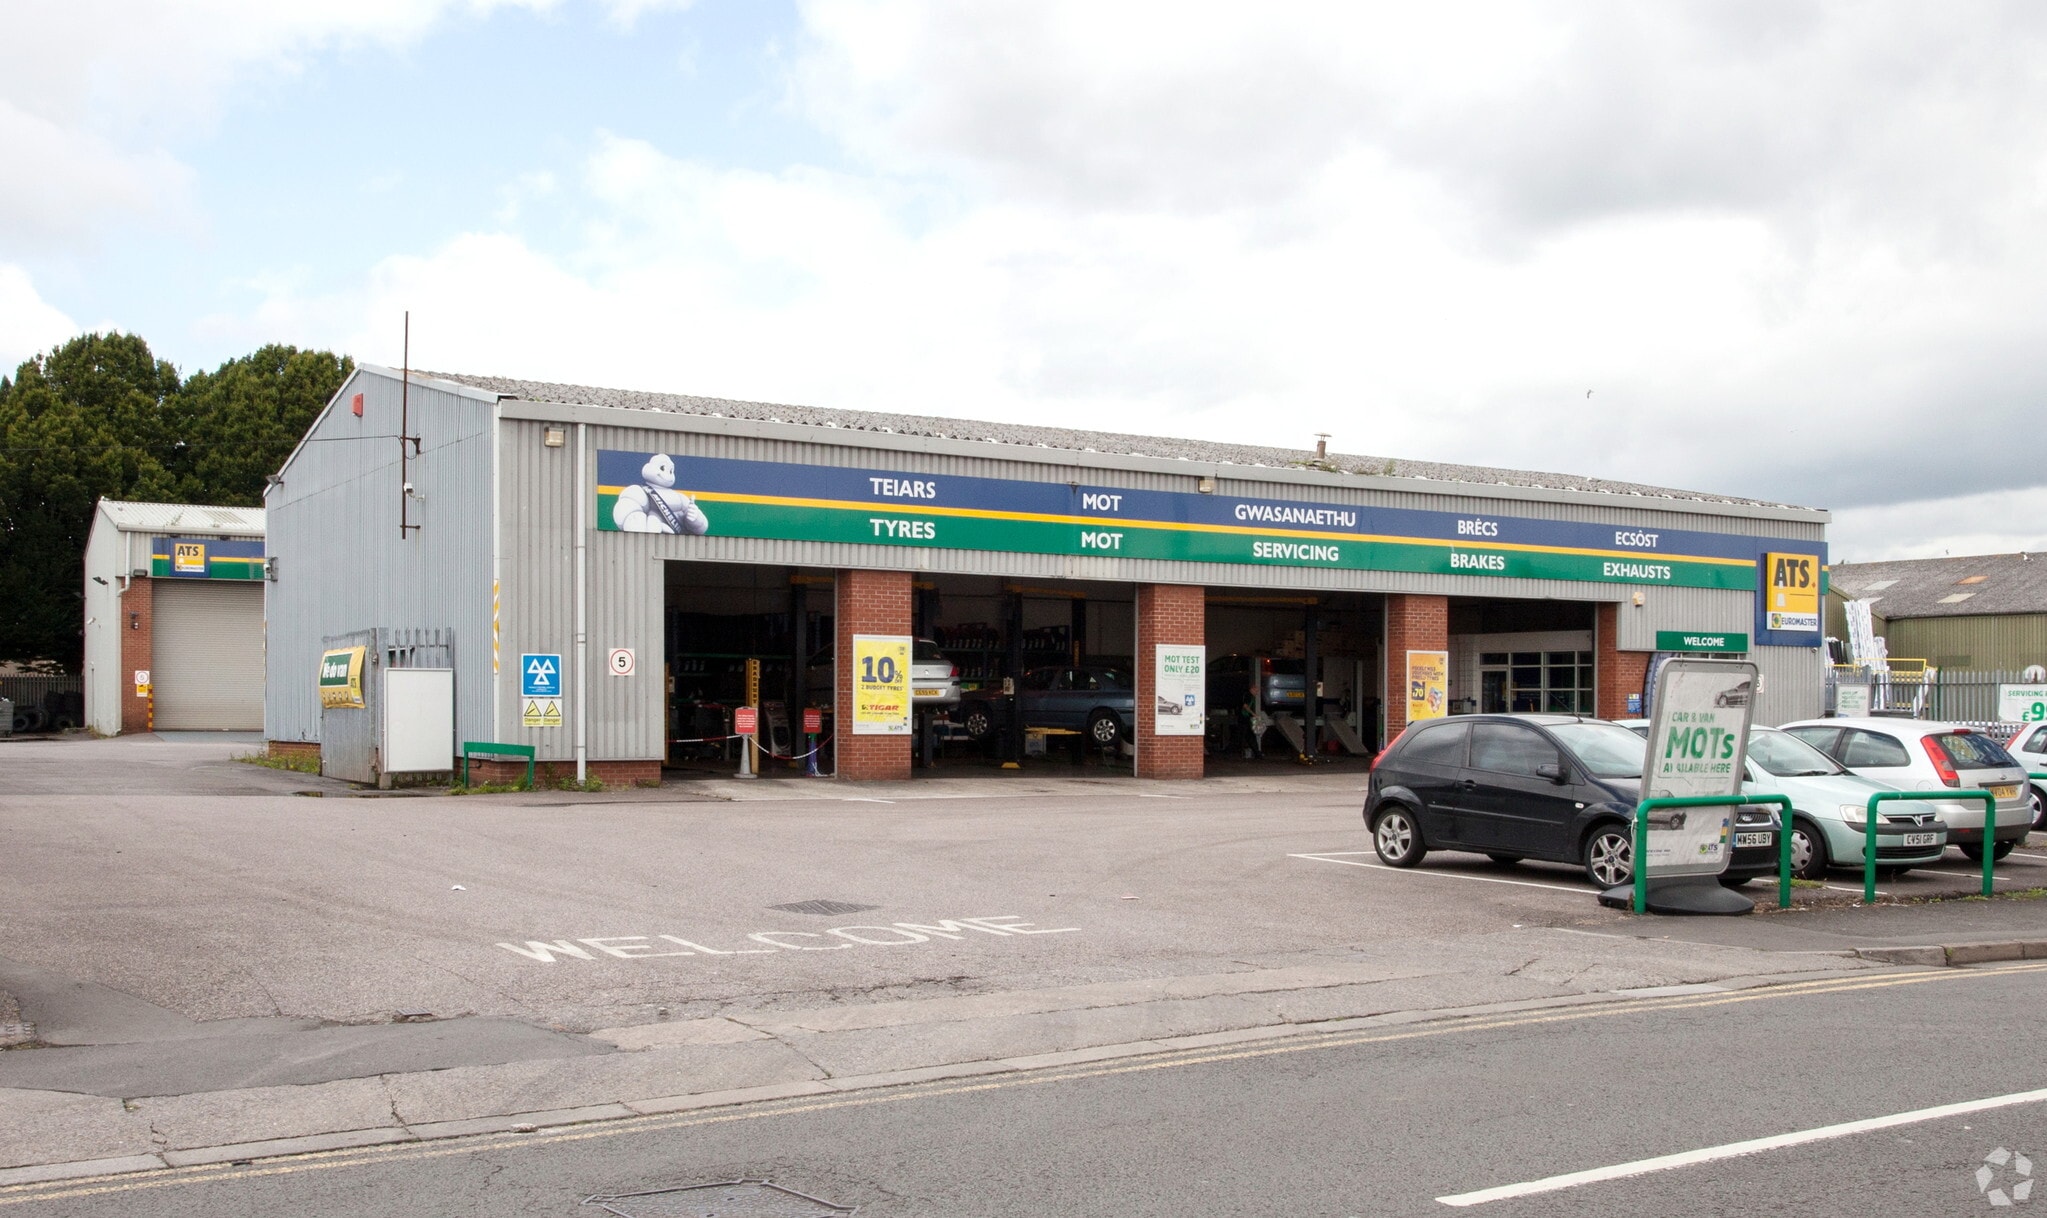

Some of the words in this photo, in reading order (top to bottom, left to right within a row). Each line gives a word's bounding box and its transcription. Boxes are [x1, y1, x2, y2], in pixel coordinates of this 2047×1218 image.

[869, 478, 936, 499] TEIARS
[1082, 493, 1122, 511] MOT
[1234, 504, 1356, 527] GWASANAETHU
[869, 519, 936, 539] TYRES
[1457, 518, 1498, 537] BRÊCS
[1081, 532, 1123, 550] MOT
[1615, 530, 1658, 548] ECSÔST
[177, 545, 199, 557] ATS
[1253, 542, 1339, 561] SERVICING
[1450, 553, 1505, 570] BRAKES
[1603, 562, 1671, 579] EXHAUSTS
[1773, 558, 1810, 589] ATS
[1781, 616, 1818, 627] EUROMASTER
[1683, 636, 1725, 647] WELCOME
[618, 656, 626, 667] 5
[1164, 655, 1180, 663] MOT
[1182, 656, 1200, 664] TEST
[1164, 665, 1183, 673] ONLY
[1185, 665, 1200, 673] £20
[1672, 712, 1689, 722] CAR
[1699, 713, 1715, 723] VAN
[2022, 702, 2047, 722] £9
[1665, 726, 1735, 759] MOTs
[1710, 763, 1732, 773] HERE
[1737, 834, 1757, 845] MW56
[1758, 833, 1771, 845] UBY
[1906, 834, 1922, 844] CV51
[1922, 833, 1935, 844] GRF
[496, 915, 1082, 963] WELCOME
